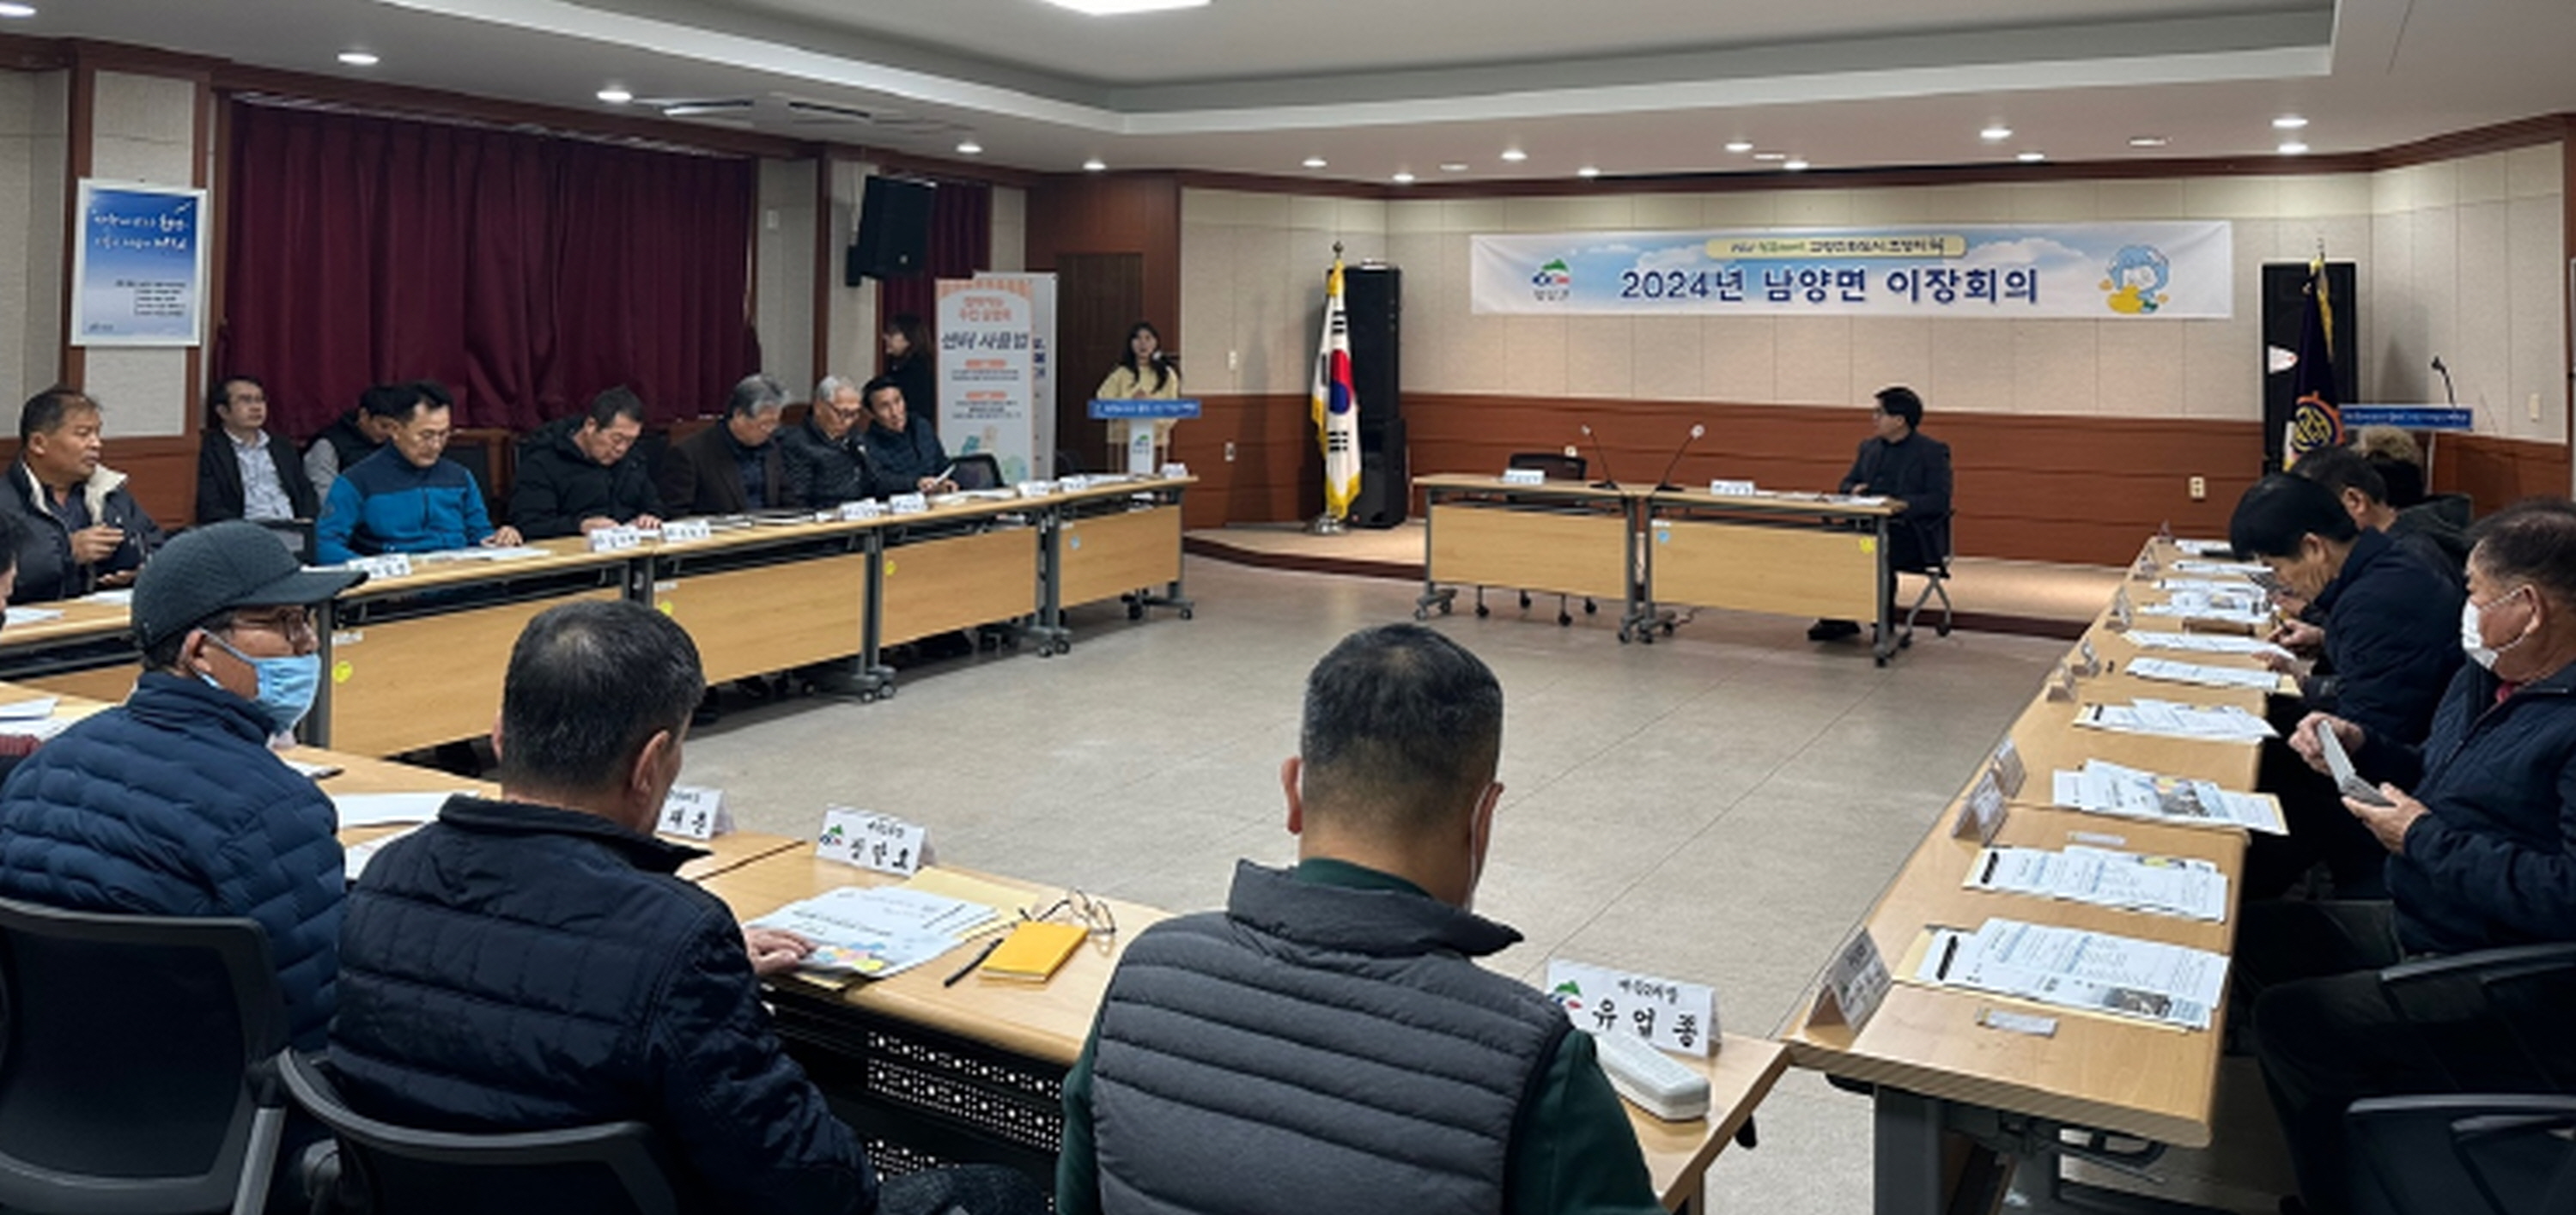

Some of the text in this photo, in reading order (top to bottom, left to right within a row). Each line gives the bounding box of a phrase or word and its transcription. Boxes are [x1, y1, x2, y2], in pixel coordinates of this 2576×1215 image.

[1620, 268, 2037, 304] 2024년 남양면 이장회의
